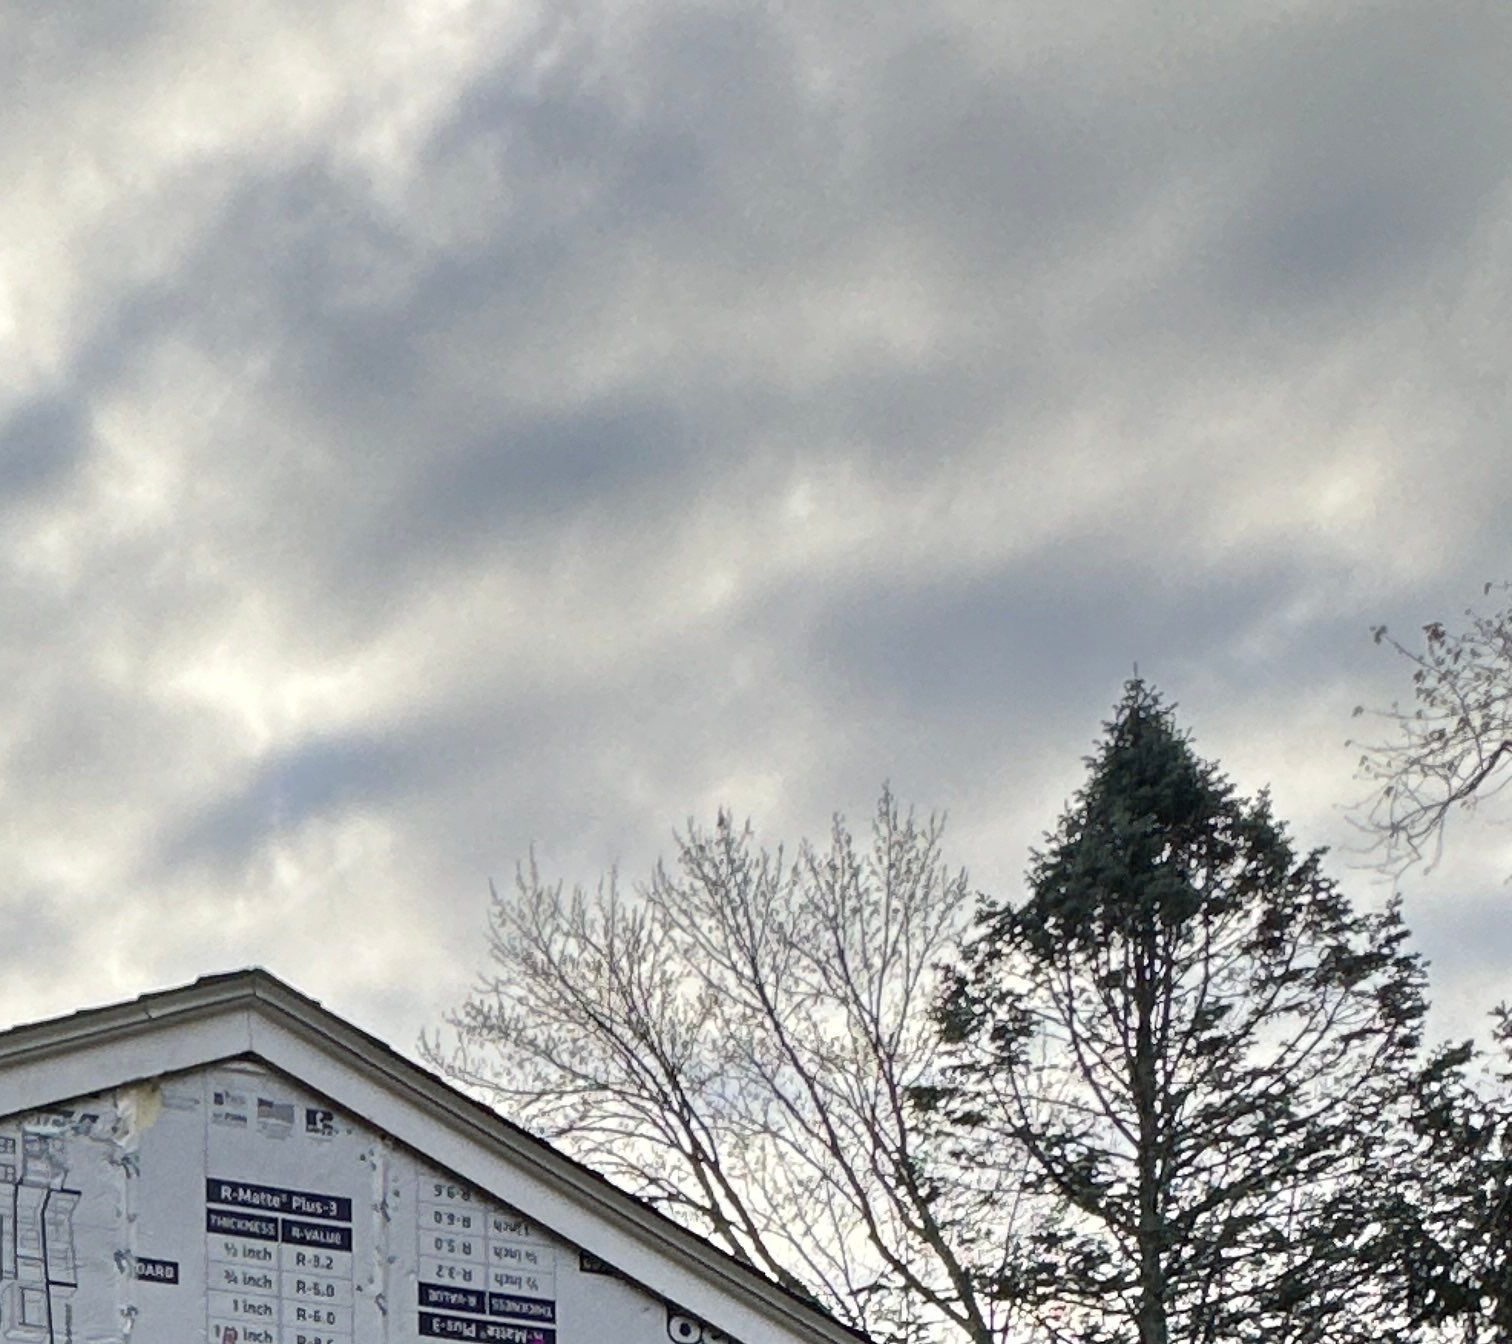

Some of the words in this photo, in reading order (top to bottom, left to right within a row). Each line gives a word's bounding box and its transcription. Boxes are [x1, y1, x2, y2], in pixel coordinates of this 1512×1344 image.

[292, 1196, 338, 1216] Plus-3
[241, 1245, 272, 1262] inch
[241, 1272, 272, 1289] inch
[241, 1300, 272, 1318] inch
[243, 1327, 273, 1344] inch
